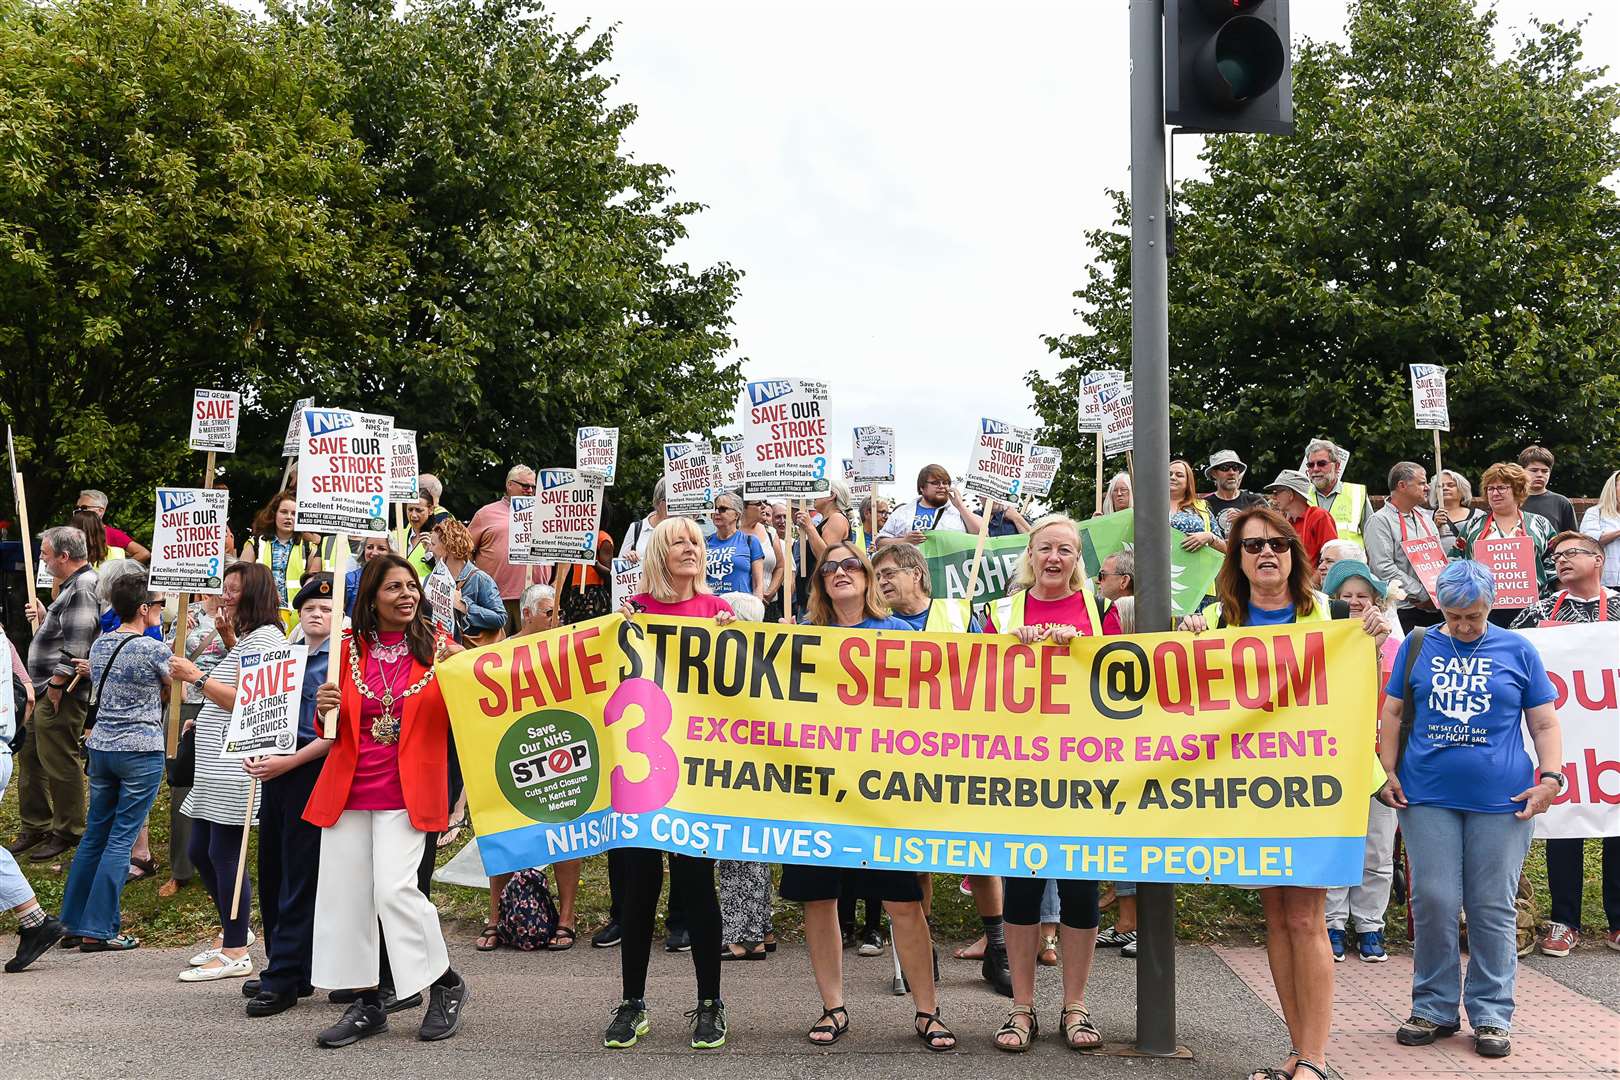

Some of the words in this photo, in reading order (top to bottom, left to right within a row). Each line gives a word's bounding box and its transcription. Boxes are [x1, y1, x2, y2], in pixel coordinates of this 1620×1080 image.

[1416, 379, 1433, 389] SAVE
[754, 381, 792, 403] NHS
[196, 400, 234, 420] SAVE
[751, 404, 788, 424] SAVE
[791, 401, 820, 419] OUR
[1103, 400, 1120, 414] SAVE
[313, 412, 353, 433] NHS
[771, 419, 826, 440] STROKE
[986, 420, 1009, 433] NHS
[308, 437, 348, 454] SAVE
[352, 438, 380, 454] OUR
[398, 444, 412, 454] OUR
[579, 439, 596, 449] SAVE
[598, 439, 612, 448] OUR
[670, 445, 690, 458] NHS
[756, 438, 825, 461] SERVICES
[981, 435, 1004, 450] SAVE
[1005, 441, 1023, 454] OUR
[588, 448, 614, 456] STROKE
[725, 453, 742, 464] SAVE
[991, 450, 1025, 466] STROKE
[330, 456, 386, 474] STROKE
[580, 457, 613, 466] SERVICES
[669, 459, 689, 471] SAVE
[691, 456, 706, 467] OUR
[813, 457, 826, 479] 3
[1028, 457, 1042, 465] SAVE
[391, 467, 415, 478] RVICES
[606, 466, 612, 475] 3
[680, 466, 710, 480] STROKE
[780, 469, 812, 477] Hospitals
[979, 460, 1021, 478] SERVICES
[312, 476, 383, 493] SERVICES
[411, 478, 416, 491] 3
[546, 472, 575, 487] NHS
[673, 478, 710, 493] SERVICES
[1009, 480, 1019, 494] 3
[164, 492, 195, 509] NHS
[542, 490, 569, 504] SAVE
[572, 490, 594, 502] OUR
[704, 488, 711, 501] 3
[300, 501, 333, 510] Excellent
[336, 504, 368, 514] Hospitals
[369, 495, 384, 517] 3
[555, 504, 597, 518] STROKE
[162, 512, 189, 528] SAVE
[193, 510, 217, 525] OUR
[514, 512, 532, 522] SAVE
[543, 518, 594, 533] SERVICES
[176, 525, 221, 542] STROKE
[583, 533, 593, 549] 3
[163, 542, 219, 559] SERVICES
[1407, 542, 1437, 553] ASHFORD
[1487, 543, 1521, 552] DON'T
[706, 553, 732, 562] OUR
[1423, 552, 1430, 560] IS
[207, 558, 219, 577] 3
[706, 562, 731, 574] NHS
[1416, 562, 1432, 572] TOO
[1433, 561, 1446, 570] FAR
[1494, 562, 1517, 570] OUR
[945, 554, 1018, 599] ASHF
[1493, 571, 1527, 579] TROKE
[1494, 581, 1529, 589] ERVICE
[243, 655, 260, 667] NHS
[263, 650, 291, 662] QEQM
[1430, 656, 1493, 675] SAVE
[473, 627, 607, 718] SAVE
[617, 620, 822, 702] STROKE
[836, 636, 1070, 715] SERVICE
[1090, 632, 1328, 720] @QEQM
[240, 659, 296, 705] SAVE
[1432, 673, 1488, 691] OUR
[259, 693, 288, 711] STROKE
[1432, 691, 1486, 713] NHS
[241, 720, 245, 730] &
[246, 706, 288, 728] MATERNITY
[252, 718, 288, 737] SERVICES
[527, 722, 556, 739] Save
[1453, 725, 1469, 733] CUT
[519, 742, 540, 755] Our
[544, 730, 572, 746] NHS
[1446, 733, 1470, 742] FIGHT
[228, 742, 234, 751] 3
[604, 678, 680, 814] 3
[686, 716, 862, 752] EXCELLENT
[870, 728, 1050, 762] HOSPITALS
[1059, 736, 1124, 763] FOR
[1134, 733, 1220, 762] EAST
[1230, 729, 1338, 760] KENT:
[512, 744, 587, 784] STOP
[524, 788, 542, 798] Cuts
[544, 783, 558, 793] and
[559, 775, 588, 788] Closures
[684, 756, 848, 803] THANET,
[858, 769, 1127, 815] CANTERBURY,
[1138, 774, 1342, 810] ASHFORD
[539, 795, 546, 804] in
[549, 790, 567, 802] Kent
[568, 786, 580, 796] and
[548, 798, 577, 812] Medway
[544, 819, 600, 856] NHS
[600, 813, 639, 844] CUTS
[650, 812, 732, 852] COST
[740, 826, 833, 858] LIVES
[872, 834, 992, 869] LISTEN
[1003, 842, 1049, 871] TO
[1058, 843, 1128, 874] THE
[1140, 845, 1294, 877] PEOPLE!
